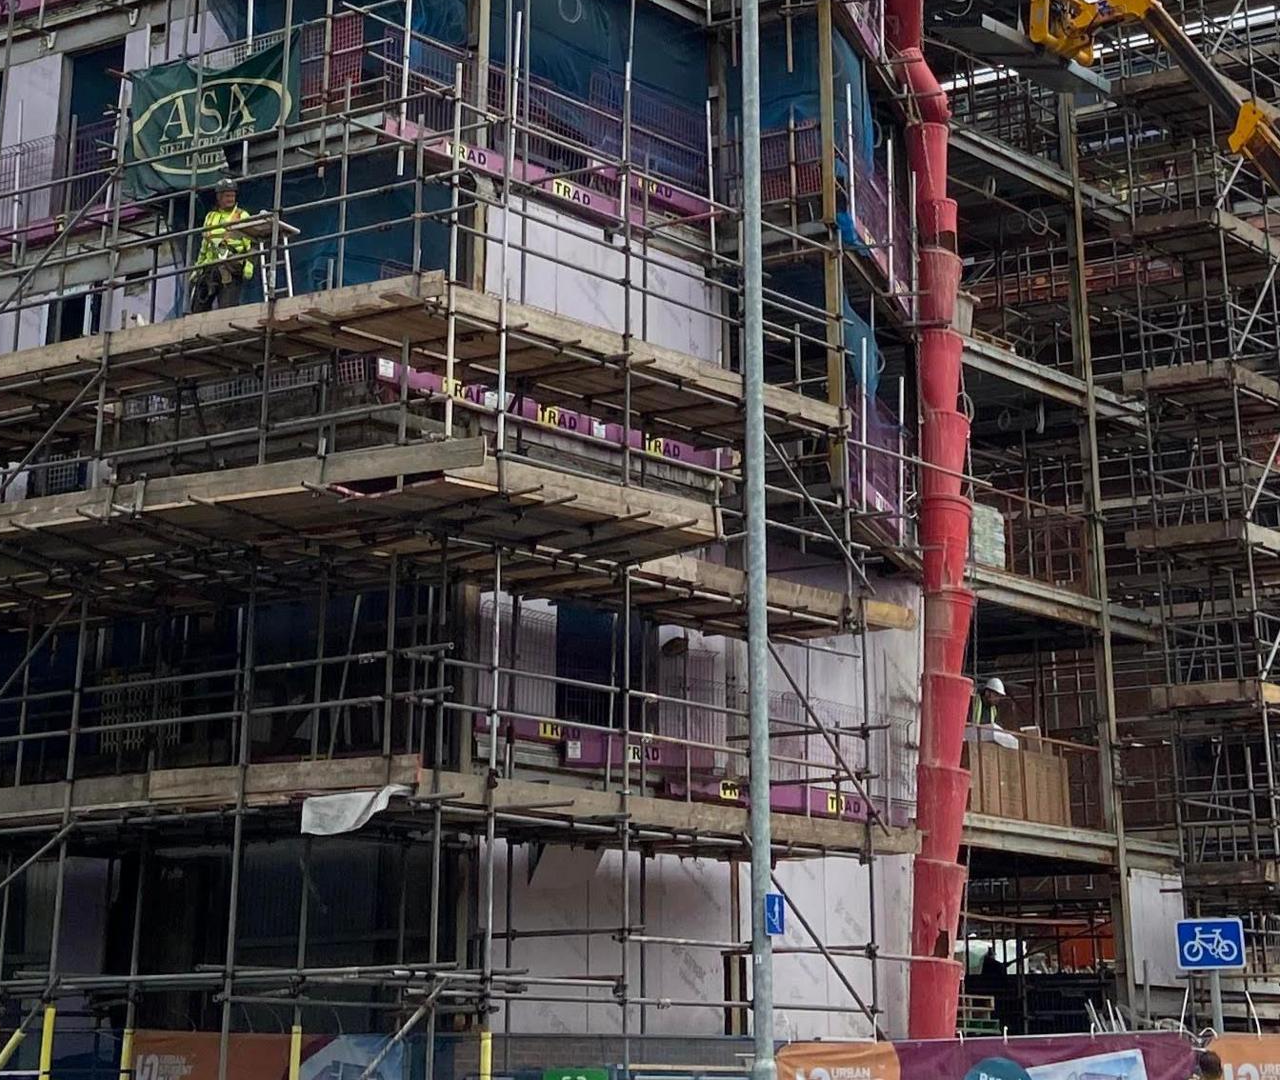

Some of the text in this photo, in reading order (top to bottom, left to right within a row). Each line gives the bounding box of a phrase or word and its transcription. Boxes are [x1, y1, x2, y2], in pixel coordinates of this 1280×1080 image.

[159, 83, 256, 142] ASA
[160, 139, 188, 156] STEEL
[554, 181, 591, 206] TRAD
[539, 407, 577, 431] TRAD
[541, 721, 580, 740] TRAD
[831, 1067, 871, 1079] URBAN
